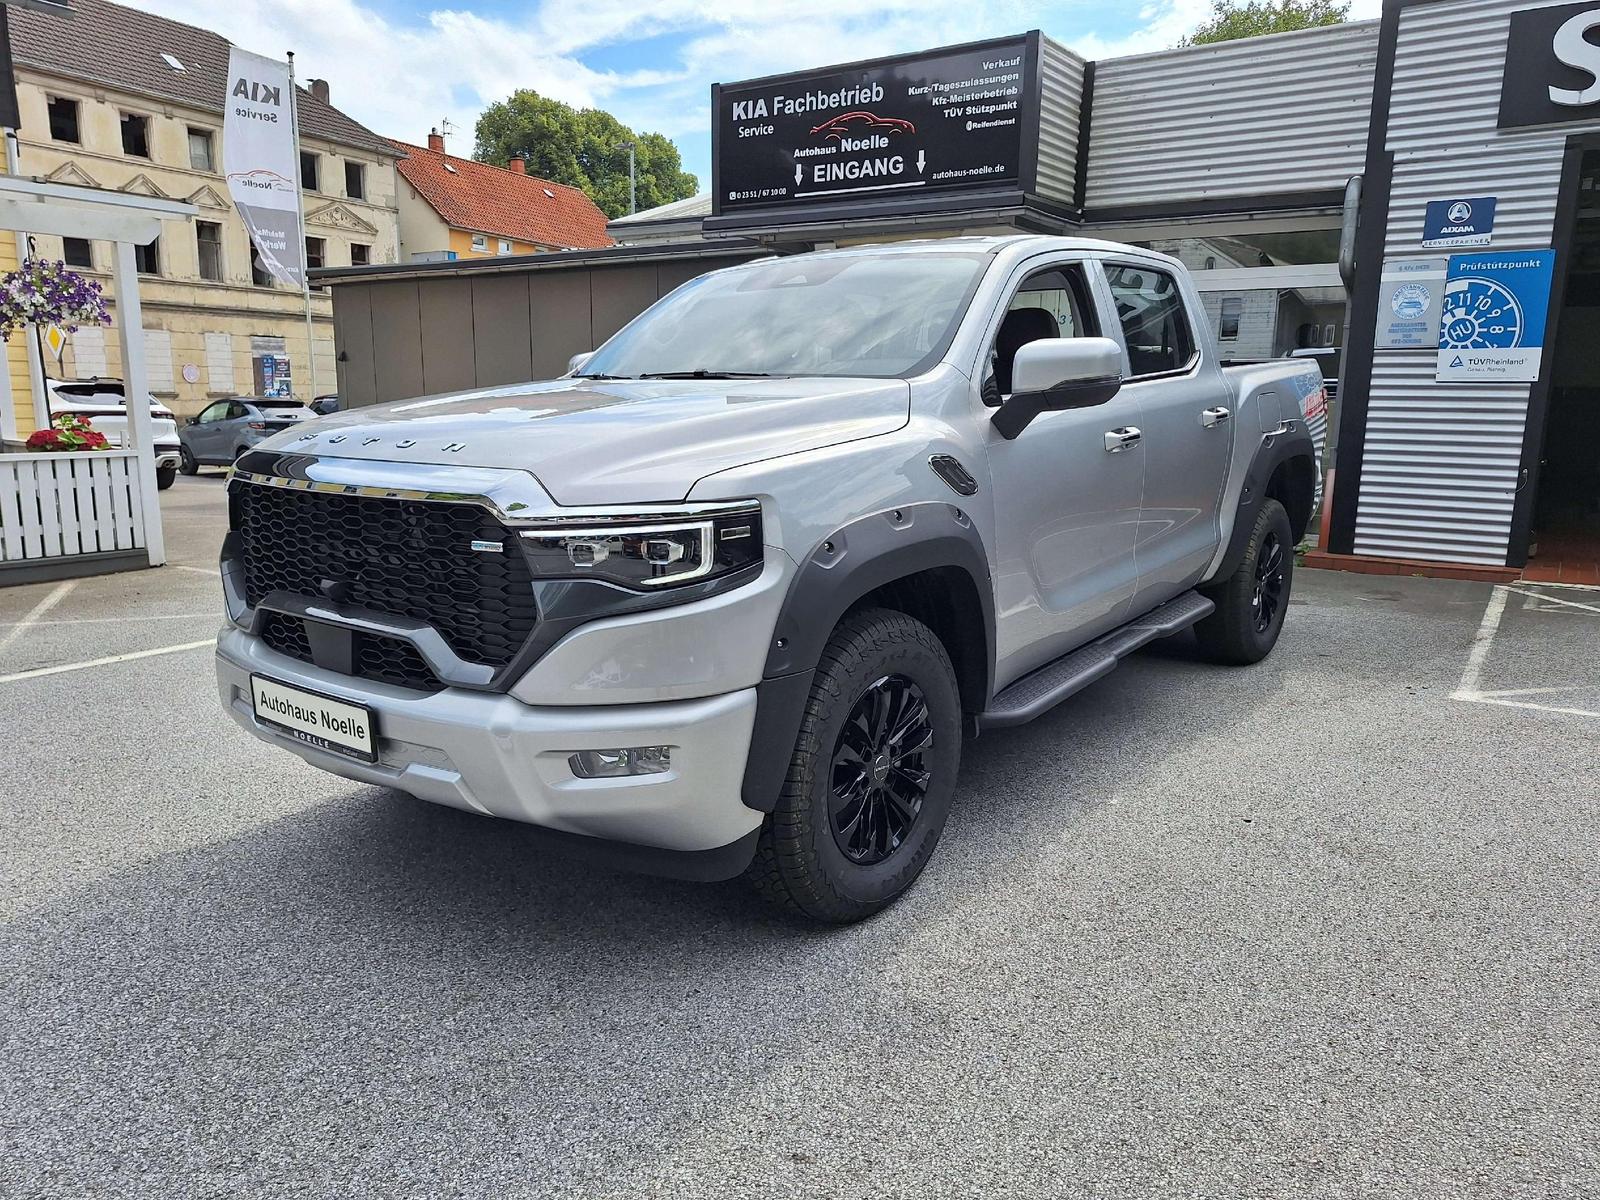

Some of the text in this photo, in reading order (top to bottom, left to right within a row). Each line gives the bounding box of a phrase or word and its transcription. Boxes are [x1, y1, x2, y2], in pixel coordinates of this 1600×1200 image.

[982, 56, 1021, 70] Verkauf
[908, 72, 1019, 96] Kurz-/Tageszulassungen
[732, 82, 884, 121] KIA Fachbetrieb
[932, 85, 1018, 106] Kfz-Meisterbetrieb
[943, 100, 1018, 118] TÜV Stützpunkt
[738, 123, 774, 138] Service
[972, 118, 1015, 129] Reifendienst
[793, 134, 889, 158] Autohaus Noelle
[813, 155, 904, 183] EINGANG
[932, 164, 1005, 180] autohaus-noelle.de
[1440, 225, 1475, 234] AIXAM
[1424, 238, 1489, 246] SERVICEPARTNER
[1460, 259, 1541, 271] Prüfstützpunkt
[1444, 297, 1455, 312] 2
[1458, 292, 1472, 306] 11
[1474, 295, 1492, 311] 10
[1486, 308, 1501, 317] 9
[1450, 320, 1472, 340] HU
[1489, 325, 1504, 334] 8
[260, 690, 365, 739] Autohaus Noelle
[293, 729, 330, 749] NOELLE
